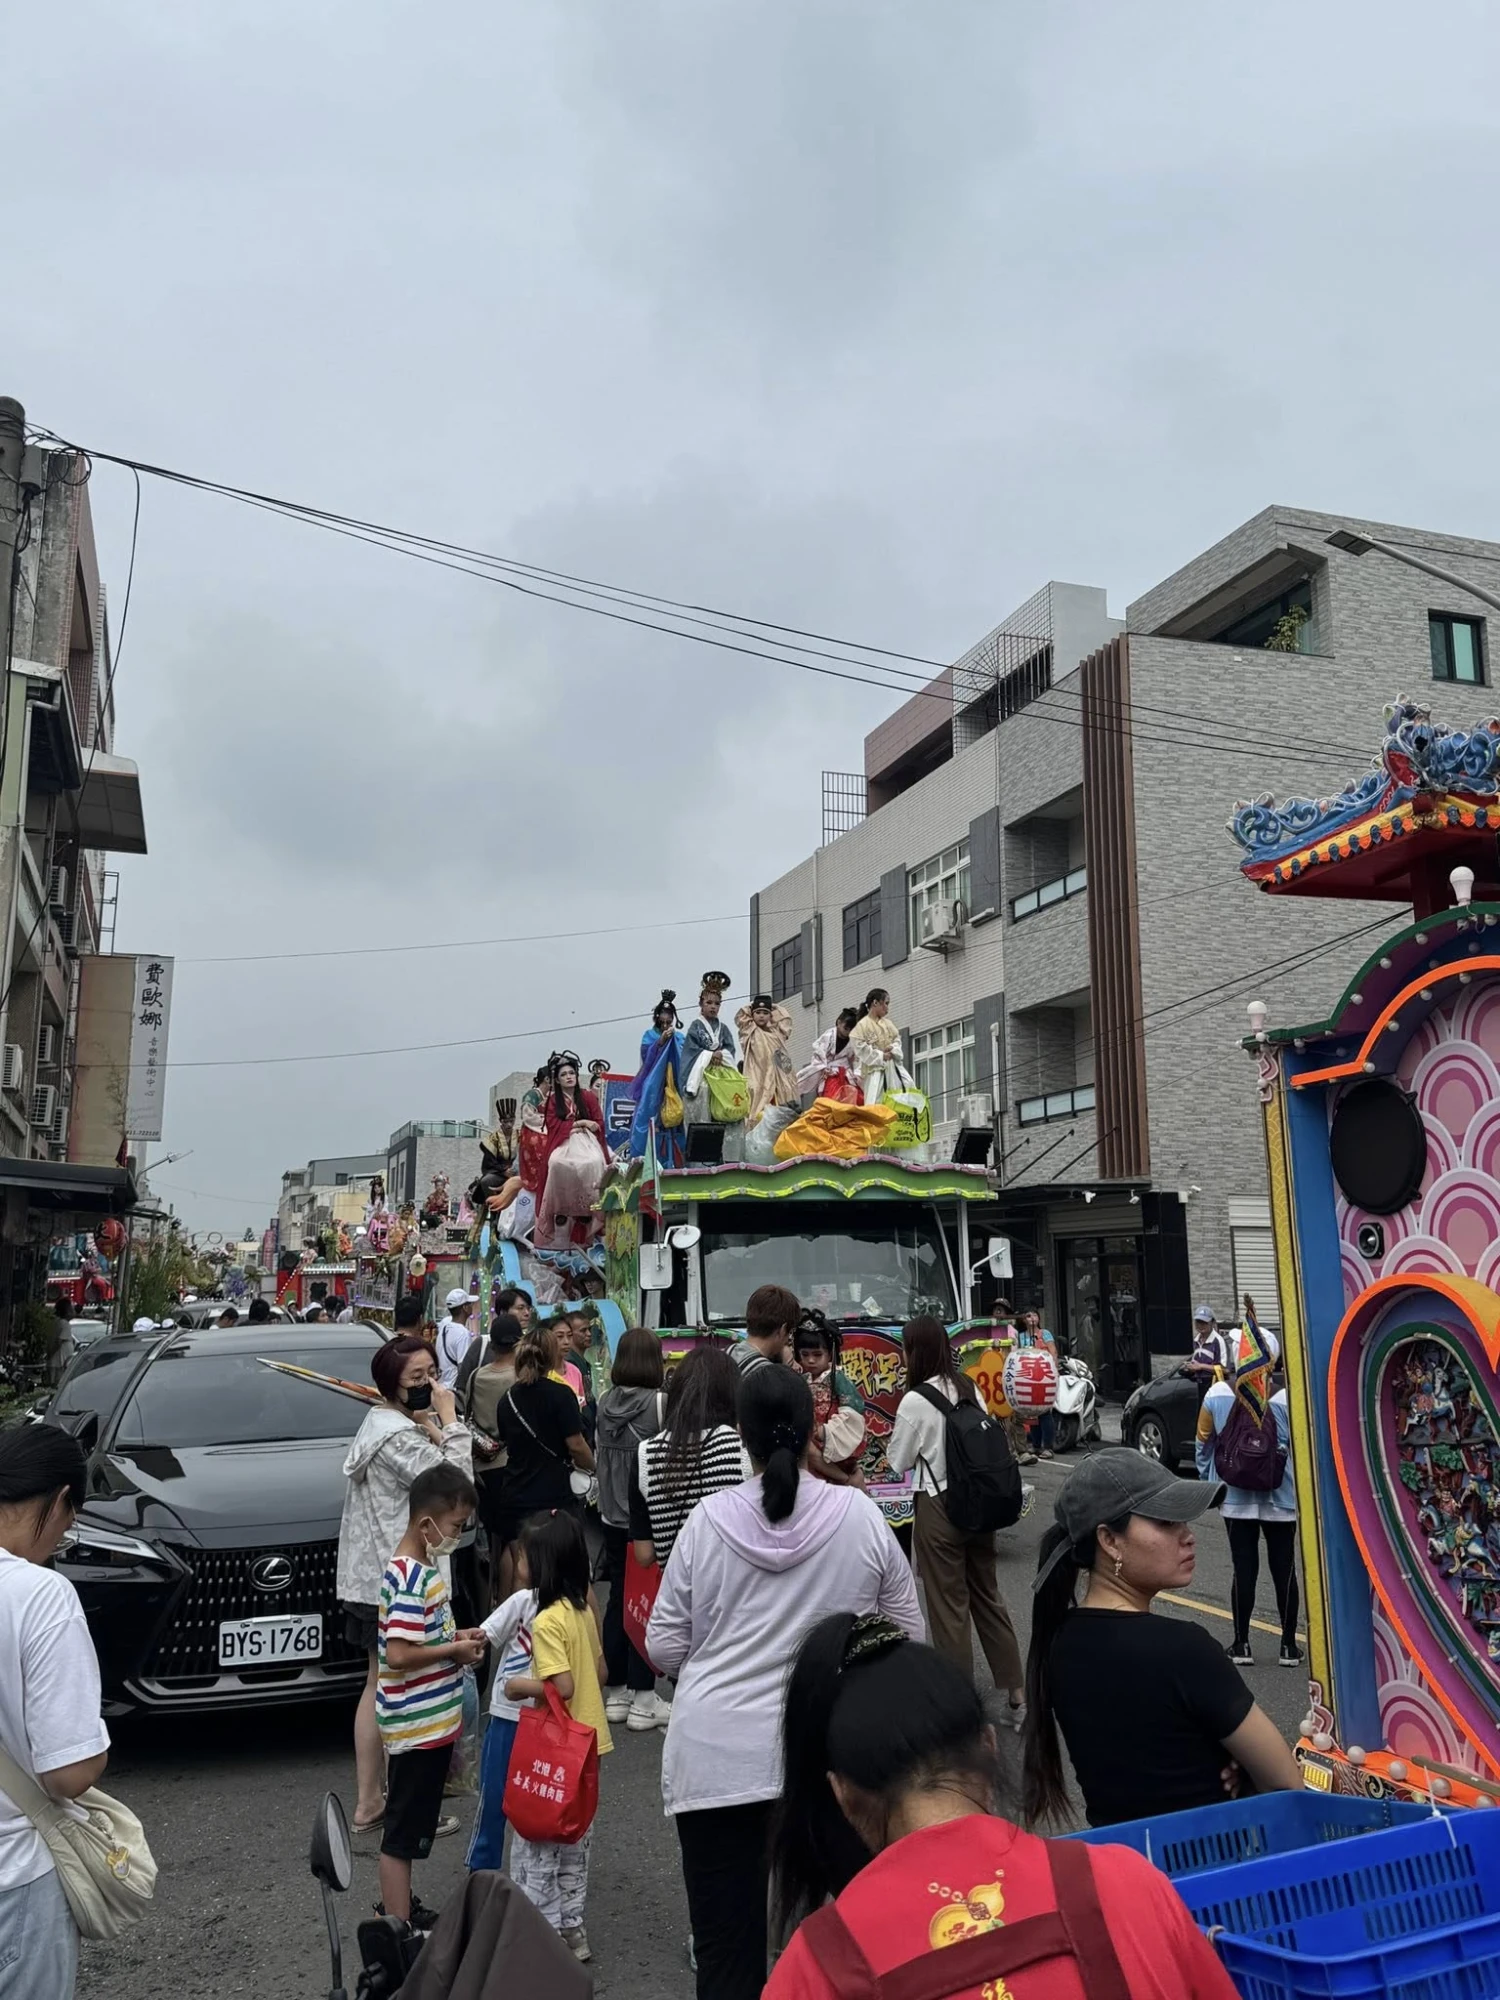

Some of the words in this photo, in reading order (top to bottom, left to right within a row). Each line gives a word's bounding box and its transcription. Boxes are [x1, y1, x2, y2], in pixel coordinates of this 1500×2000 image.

[138, 963, 165, 1032] 費歐娜
[839, 1347, 908, 1397] 戰呂
[976, 1371, 1007, 1405] 38
